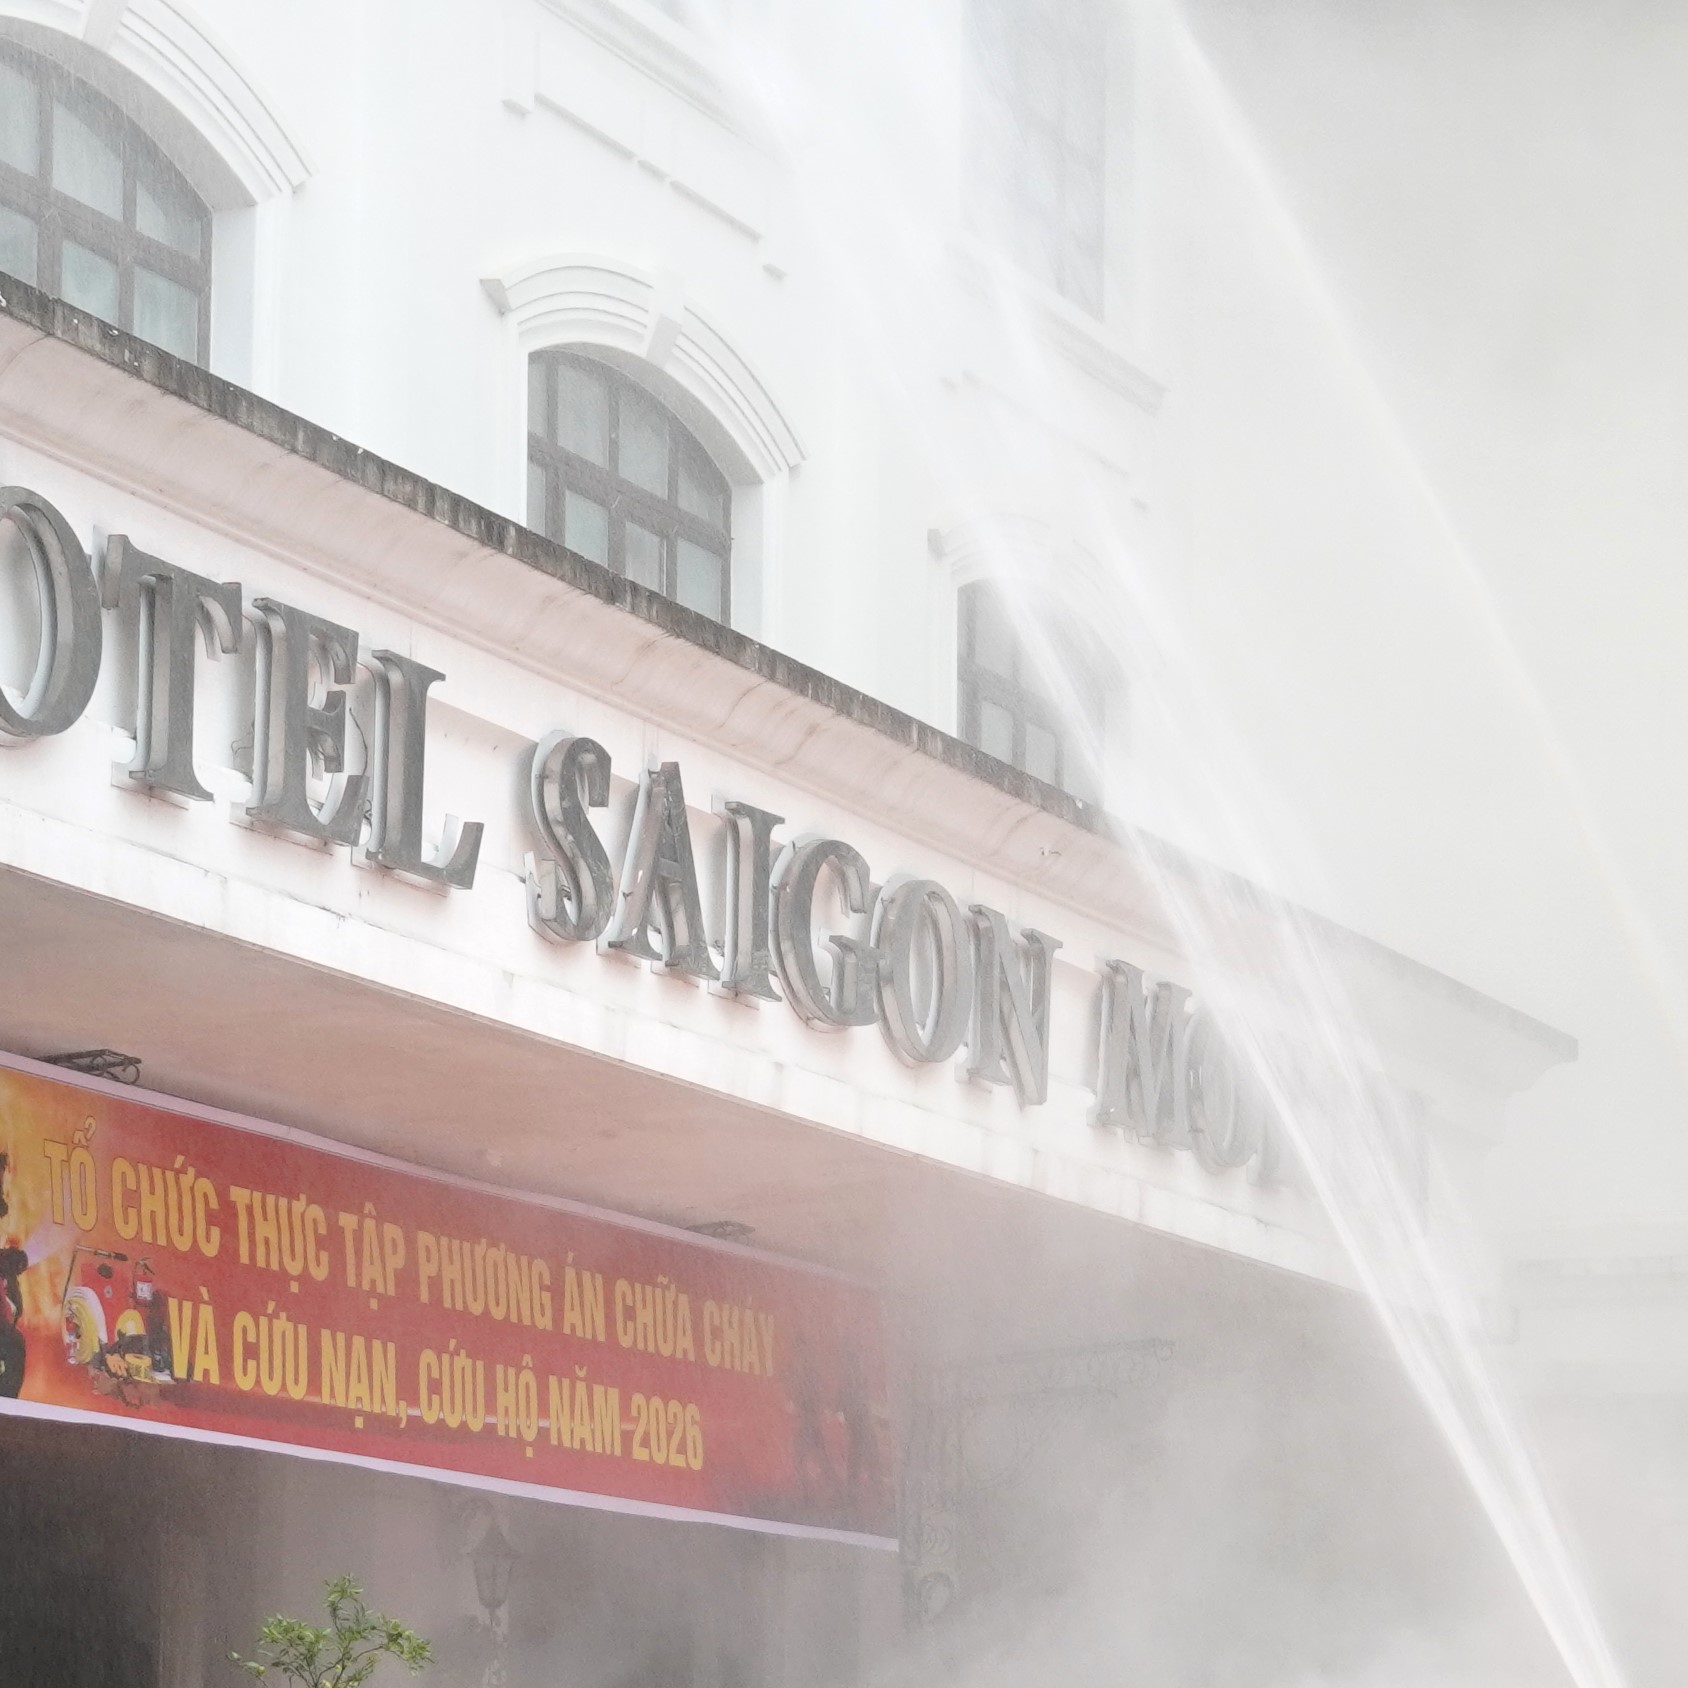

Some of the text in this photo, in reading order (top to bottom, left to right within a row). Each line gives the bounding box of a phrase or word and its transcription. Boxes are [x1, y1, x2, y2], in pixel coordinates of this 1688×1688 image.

[0, 484, 482, 890] OTEL
[524, 730, 1063, 1109] SAIGON
[43, 1115, 776, 1377] TỔ CHỨC THỰC TẬP PHƯƠNG ÁN CHỮA CHÁY
[168, 1286, 704, 1471] VÀ CỨU NẠN, CỨU HỘ NĂM 2026
